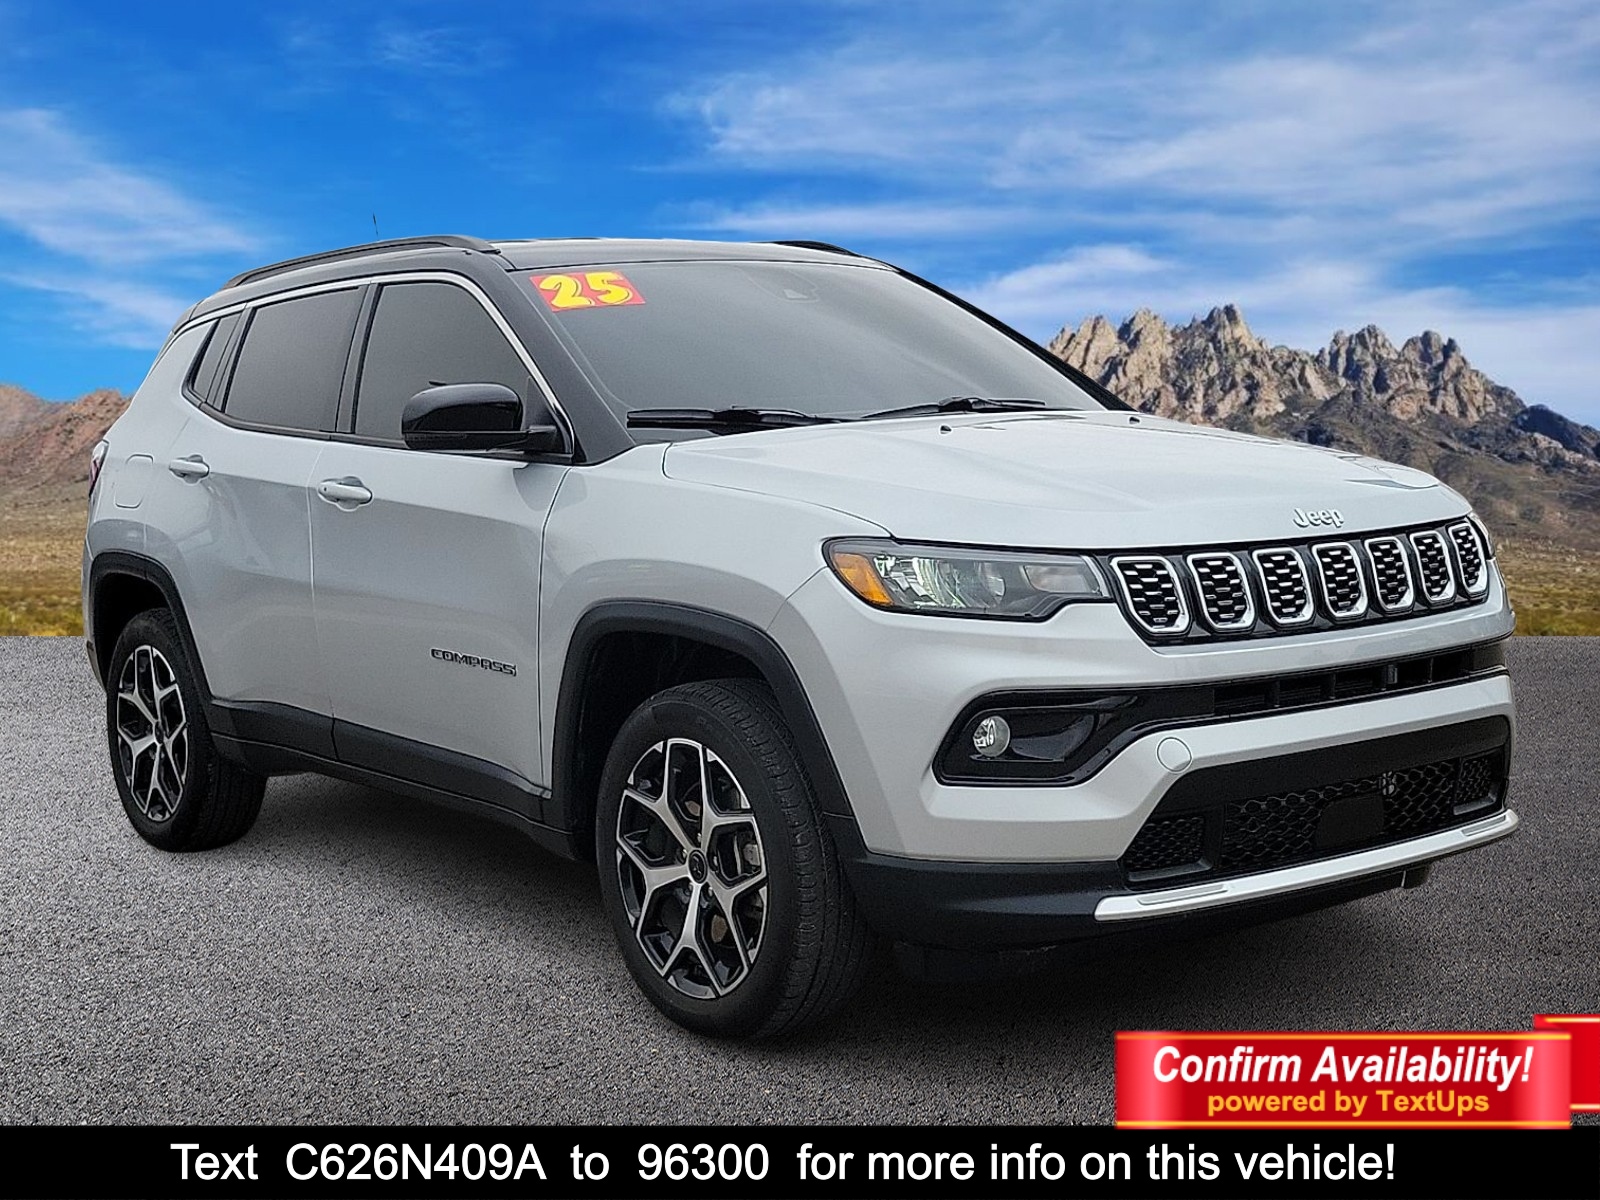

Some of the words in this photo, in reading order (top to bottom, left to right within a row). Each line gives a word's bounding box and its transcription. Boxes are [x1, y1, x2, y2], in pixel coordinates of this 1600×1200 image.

[540, 272, 633, 308] 25
[1293, 507, 1344, 528] Jeep
[430, 648, 517, 677] COMPASS
